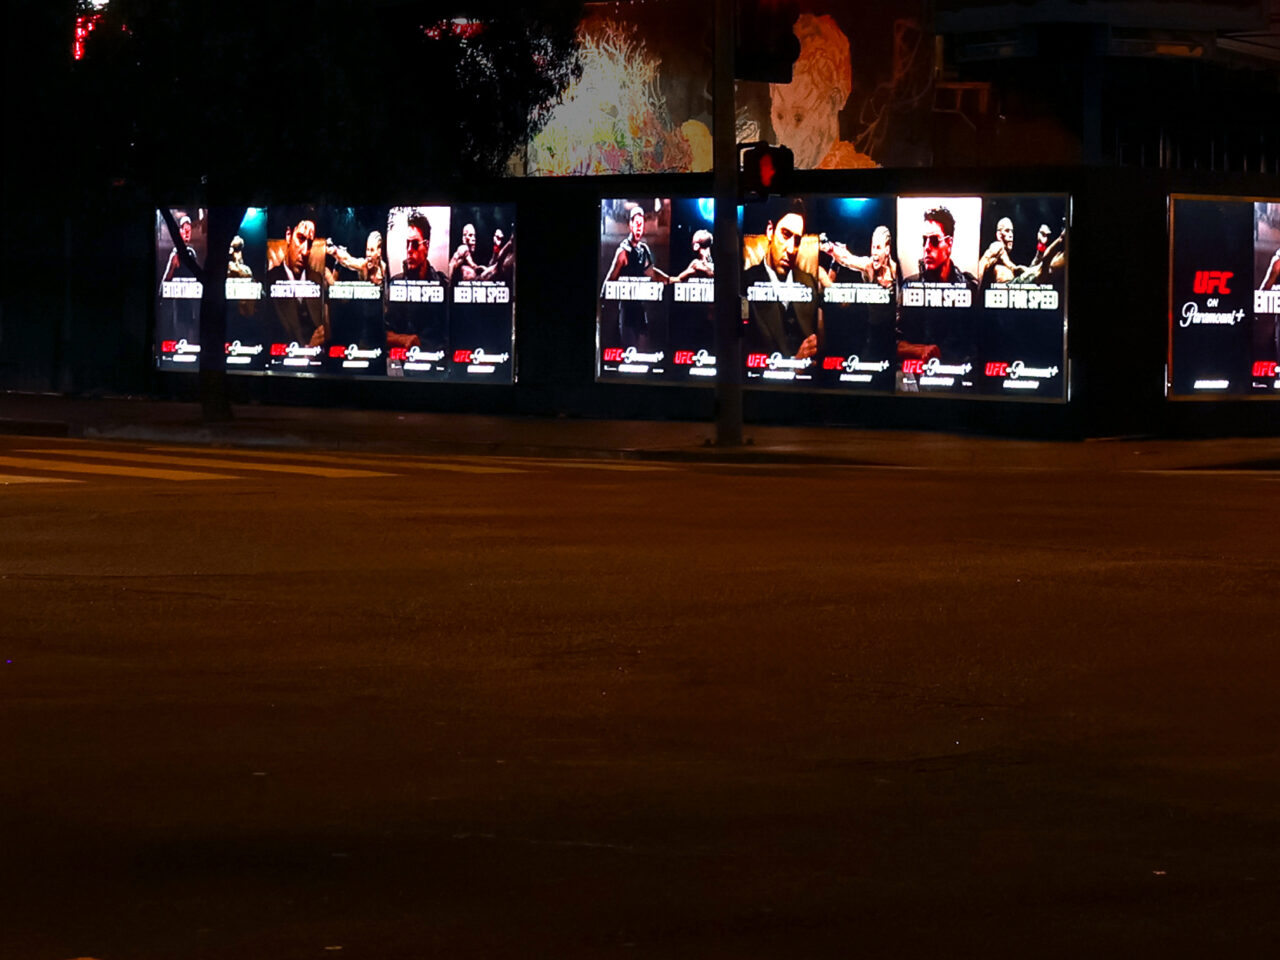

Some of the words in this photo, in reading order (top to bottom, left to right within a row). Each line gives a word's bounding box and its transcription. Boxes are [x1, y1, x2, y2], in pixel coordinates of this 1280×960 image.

[1194, 271, 1234, 294] UFC
[903, 288, 924, 306] NEED
[925, 289, 943, 307] FOR
[943, 289, 972, 307] SPEED
[984, 289, 1008, 308] NEED
[1009, 290, 1028, 309] FOR
[1028, 290, 1059, 309] SPEED
[1179, 302, 1245, 327] Paramount+
[604, 348, 623, 361] UFC
[675, 351, 695, 364] UFC
[747, 354, 768, 367] UFC
[903, 360, 925, 374] UFC
[985, 362, 1009, 376] UFC
[1253, 361, 1277, 376] UFC
